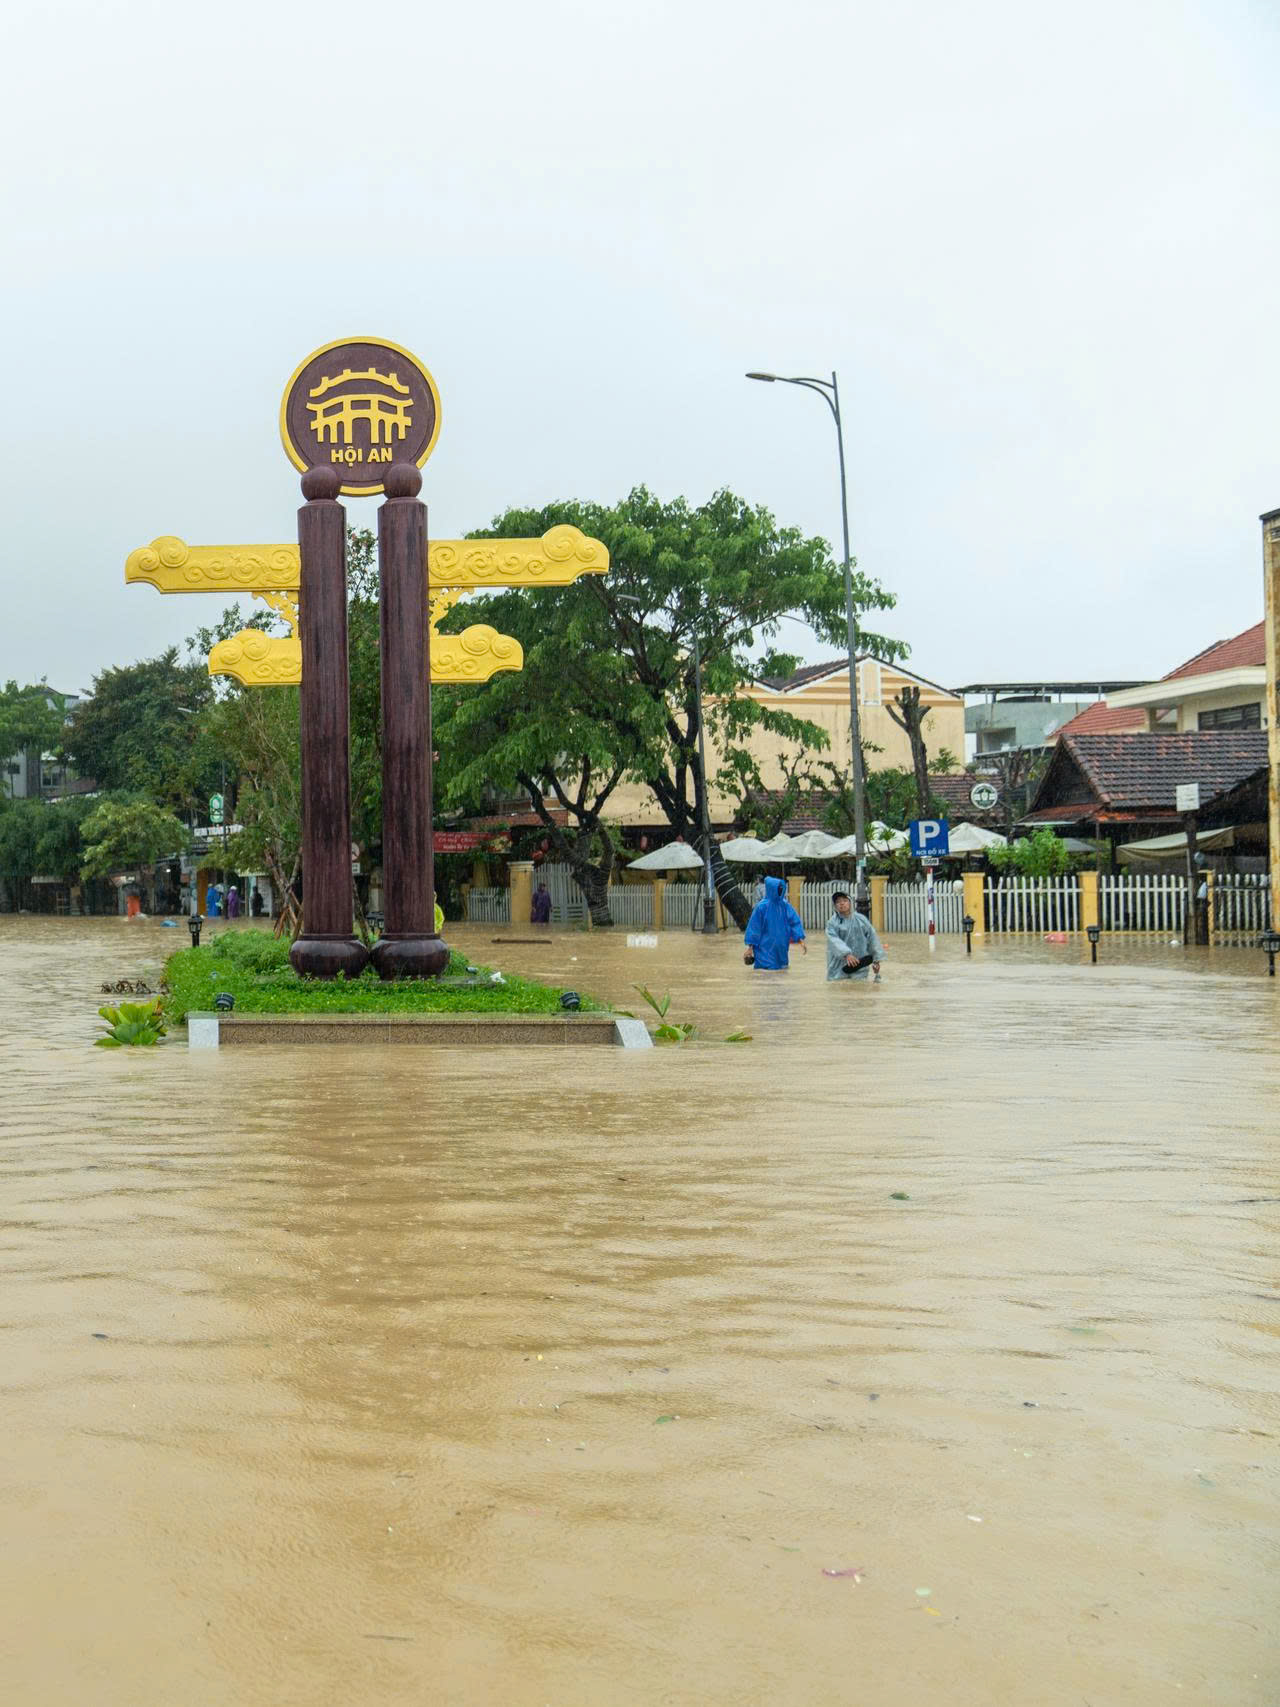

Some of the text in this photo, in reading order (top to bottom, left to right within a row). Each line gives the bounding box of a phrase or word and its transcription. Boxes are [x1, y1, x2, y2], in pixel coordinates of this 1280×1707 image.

[330, 445, 393, 467] HỘI AN
[918, 820, 940, 848] P
